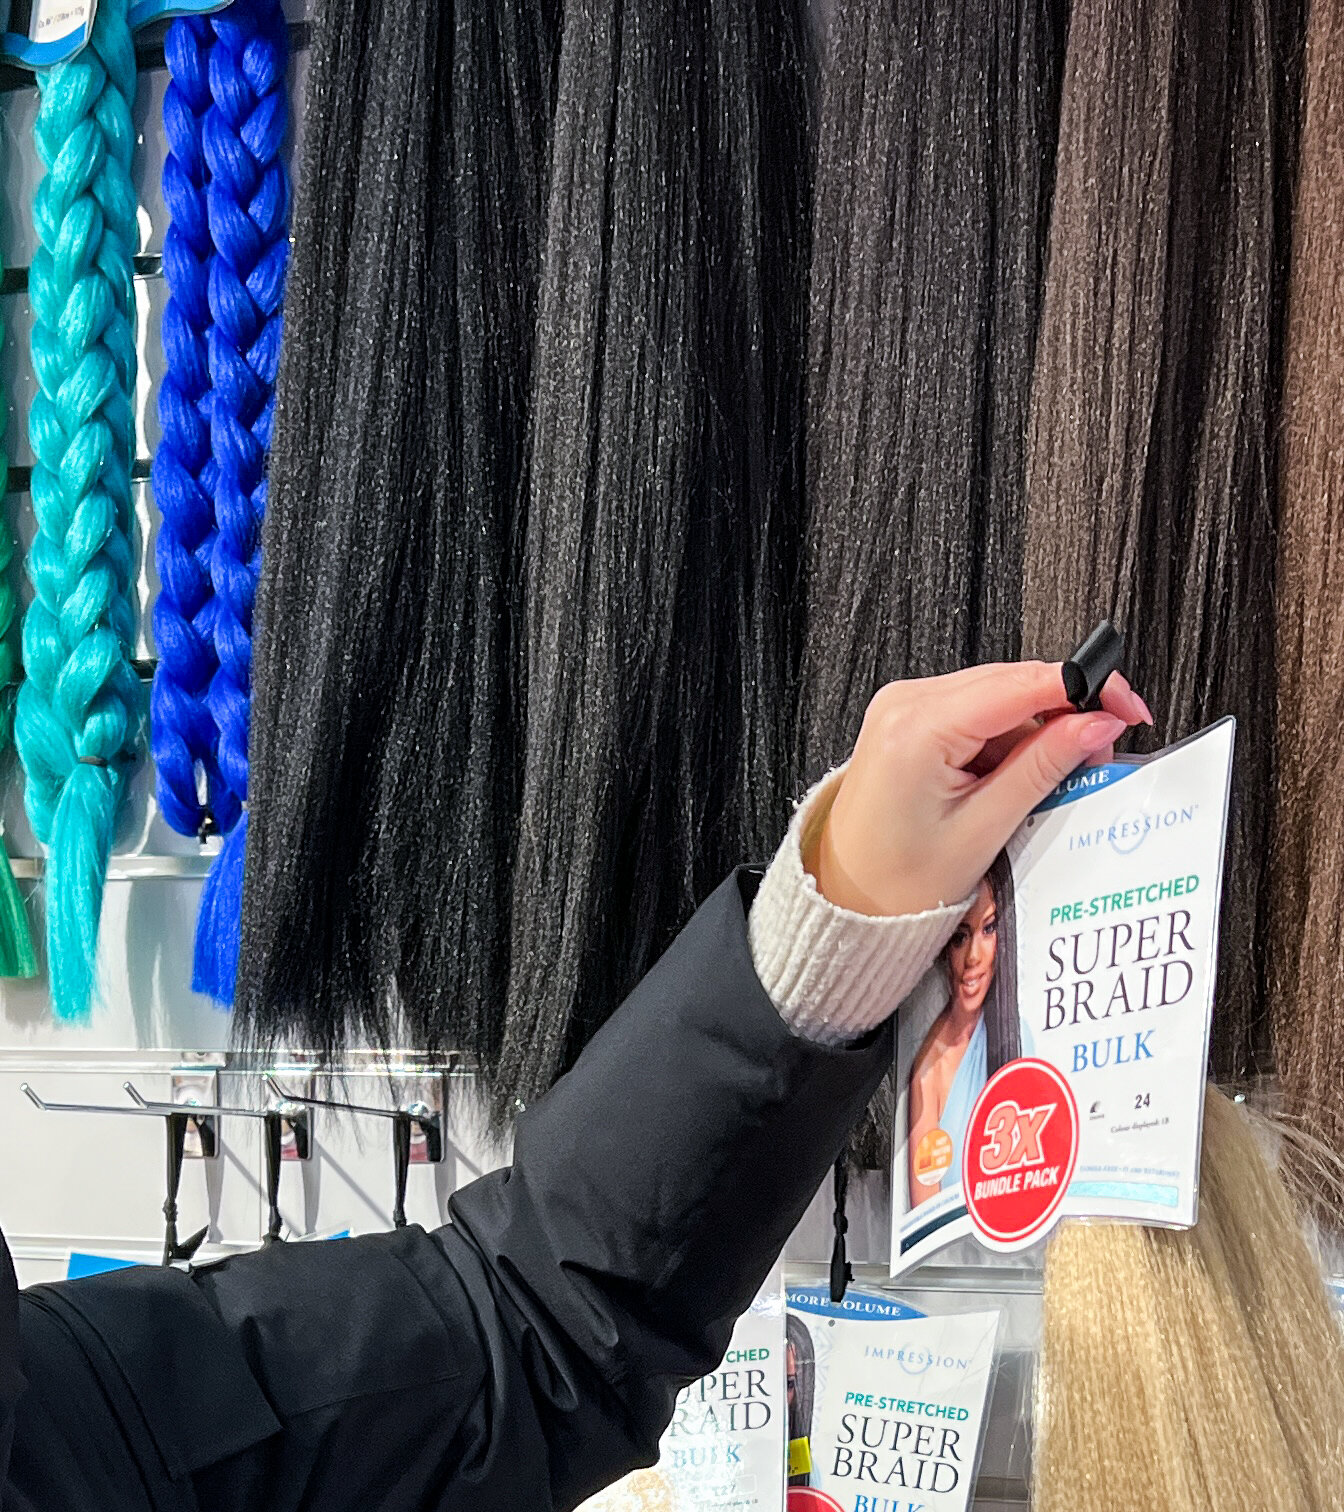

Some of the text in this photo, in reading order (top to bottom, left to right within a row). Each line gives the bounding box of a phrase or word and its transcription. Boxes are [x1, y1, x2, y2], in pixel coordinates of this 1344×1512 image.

[1069, 806, 1194, 850] IMPRESSION
[1049, 874, 1200, 925] PRE-STRETCHED
[1045, 909, 1196, 982] SUPER
[1042, 960, 1194, 1031] BRAID
[1071, 1029, 1155, 1073] BULK
[1134, 1092, 1151, 1109] 24
[974, 1172, 1021, 1201] BUNDLE
[1023, 1166, 1060, 1191] PACK
[840, 1299, 902, 1317] OLUME
[864, 1345, 968, 1369] IMPRESSION
[668, 1401, 771, 1437] RAID
[844, 1392, 969, 1421] PRE-STRETCHED
[837, 1413, 962, 1461] SUPER
[830, 1446, 959, 1494] BRAID
